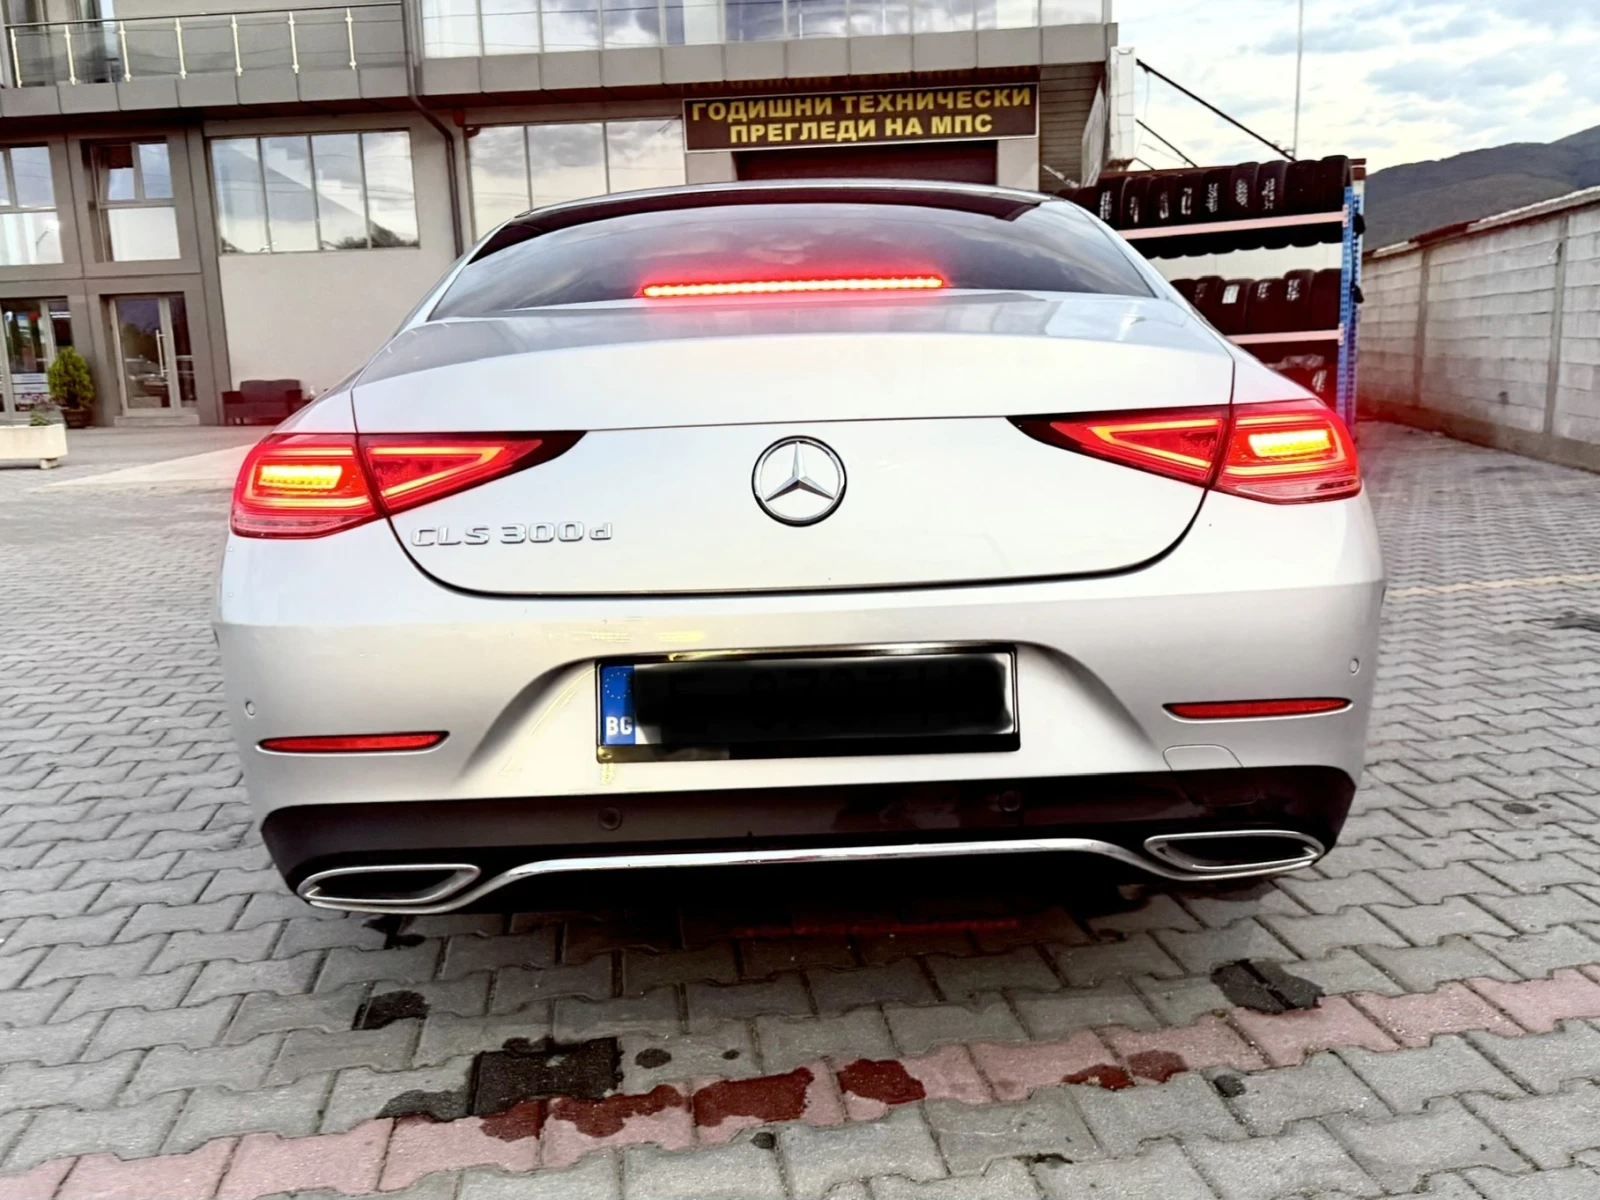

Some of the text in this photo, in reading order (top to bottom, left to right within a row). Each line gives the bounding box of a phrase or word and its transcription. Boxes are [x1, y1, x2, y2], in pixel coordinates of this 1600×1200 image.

[692, 88, 1031, 122] ГОДИШНИ ТЕХНИЧЕСКИ
[730, 114, 993, 144] ПРЕГЛЕДИ НА МПС
[411, 526, 490, 546] CLS
[606, 716, 633, 735] BG
